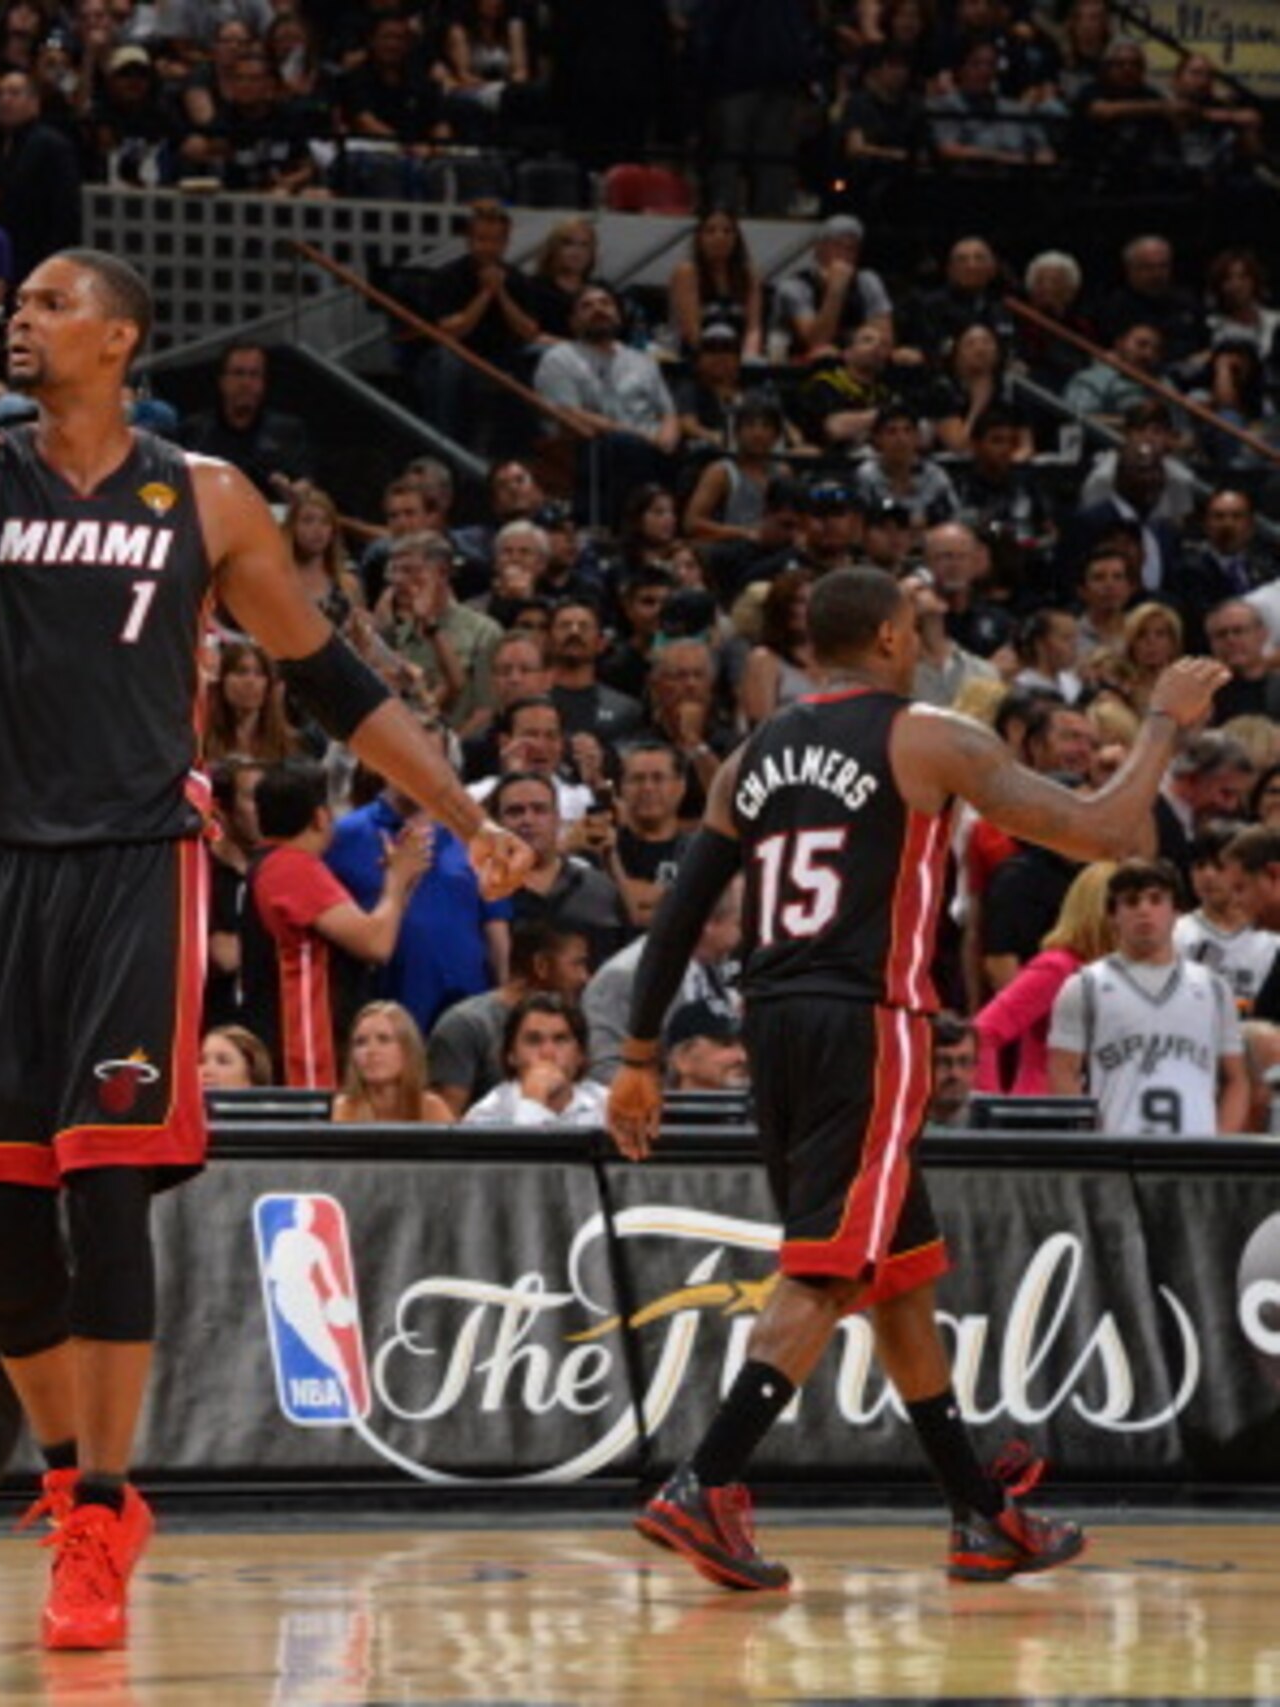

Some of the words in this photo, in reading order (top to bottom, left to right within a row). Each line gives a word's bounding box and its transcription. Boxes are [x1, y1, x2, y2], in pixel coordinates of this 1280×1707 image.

[121, 579, 157, 643] 1
[735, 745, 879, 821] CHALMERS
[754, 826, 848, 946] 15
[1141, 1086, 1181, 1136] 9
[373, 1271, 613, 1420] The
[290, 1377, 342, 1407] NBA
